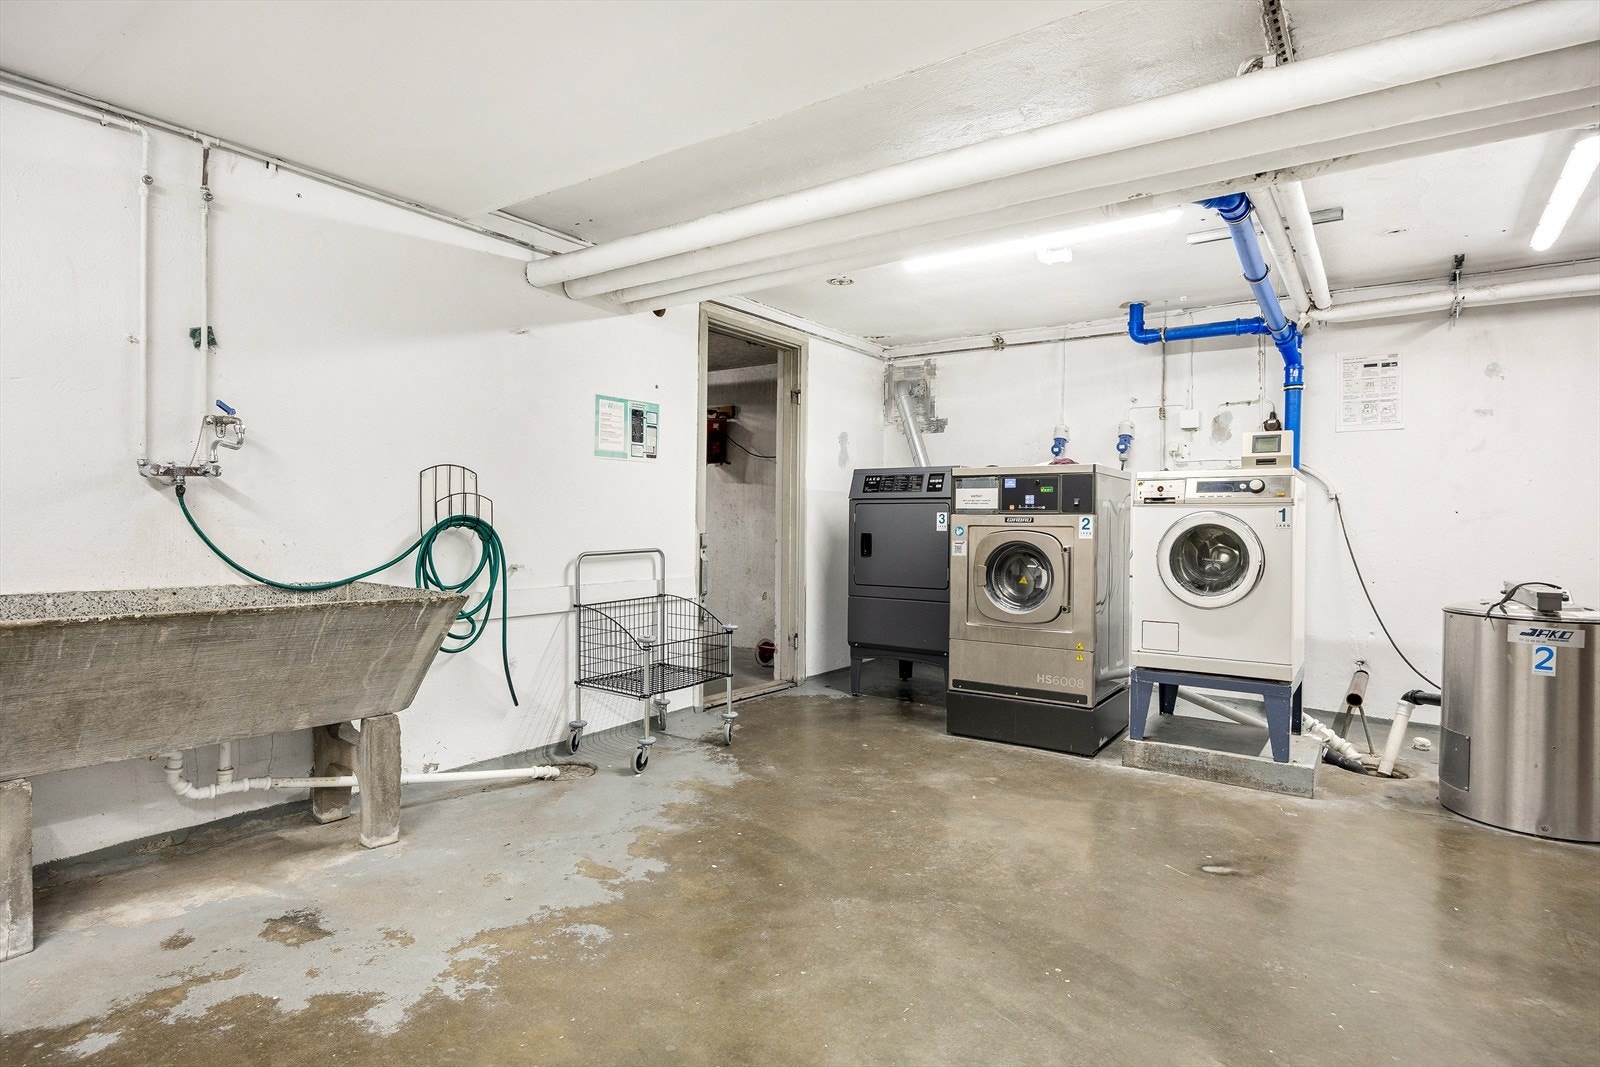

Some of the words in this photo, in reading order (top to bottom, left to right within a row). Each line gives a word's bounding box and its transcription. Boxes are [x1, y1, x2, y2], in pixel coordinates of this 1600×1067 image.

[938, 513, 946, 524] 3
[1278, 508, 1286, 522] 1
[1081, 517, 1091, 531] 2
[1520, 628, 1574, 639] JAKO
[1535, 646, 1554, 671] 2
[1036, 673, 1084, 689] HS6008
